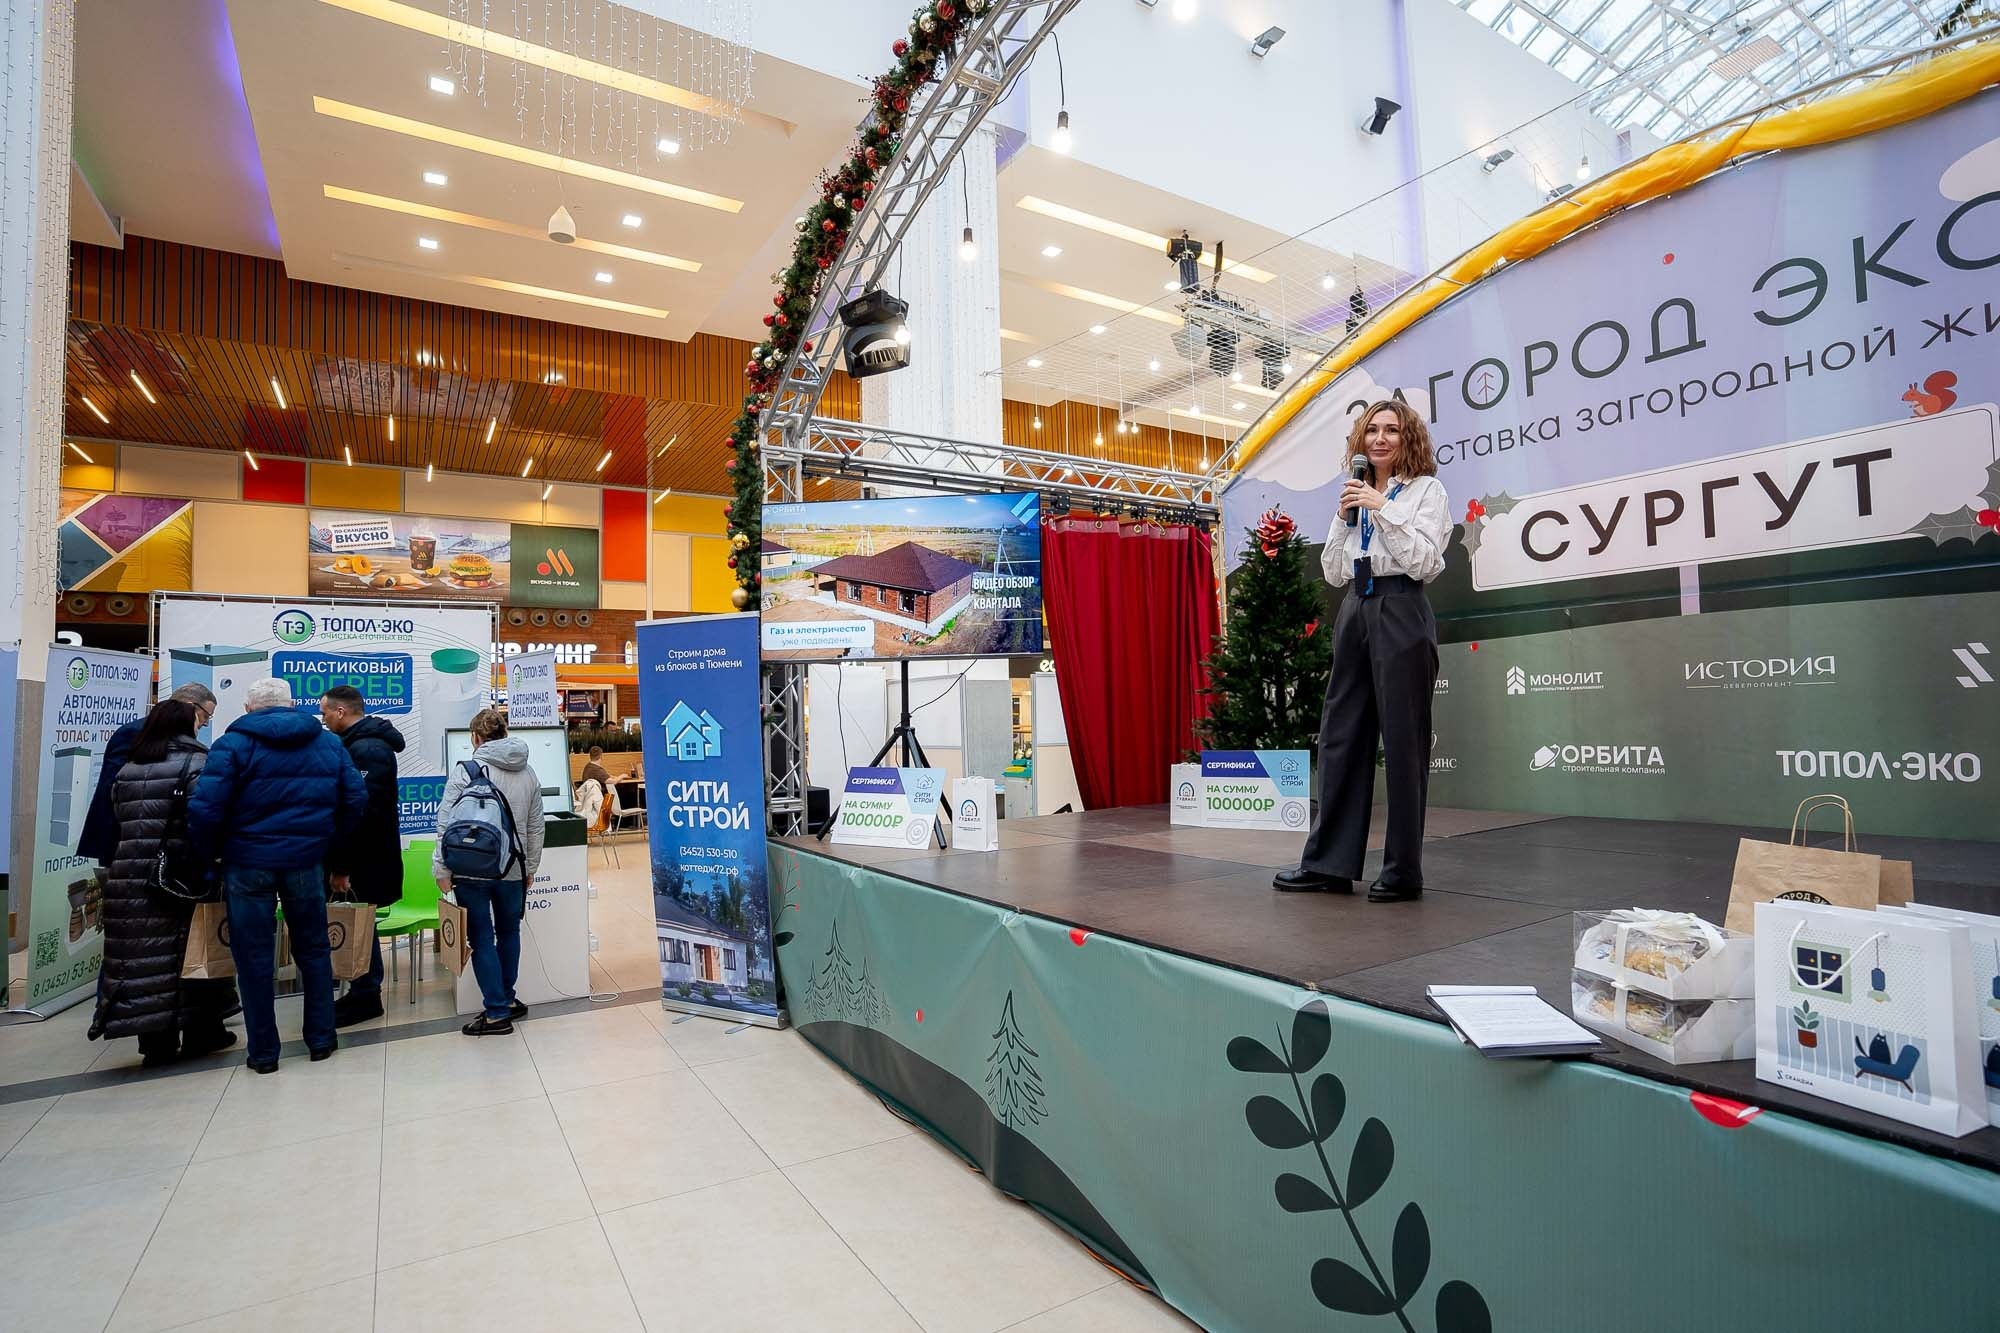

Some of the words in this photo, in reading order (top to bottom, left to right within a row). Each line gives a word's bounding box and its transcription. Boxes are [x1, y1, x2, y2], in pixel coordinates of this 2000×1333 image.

[1436, 416, 1561, 466] ставка
[1575, 326, 1896, 432] загородной
[1520, 448, 1893, 562] СУРГУТ
[335, 531, 389, 544] ВКУСНО
[973, 576, 1004, 591] ВИДЕО
[1006, 576, 1035, 589] ОБЗОР
[973, 597, 1022, 609] КВАРТАЛА
[770, 627, 786, 636] Газ
[796, 625, 867, 635] электричество
[668, 649, 702, 660] Строим
[703, 648, 726, 658] дома
[283, 660, 404, 674] ПЛАСТИКОВЫЙ
[655, 664, 666, 672] из
[667, 662, 698, 671] блоков
[706, 659, 743, 669] Тюмени
[1685, 655, 1836, 680] ИСТОРИЯ
[282, 674, 404, 697] ПОГРЕБ
[1530, 671, 1604, 686] МОНОЛИТ
[1723, 681, 1792, 689] ДЕВЕЛОПМЕНТ
[63, 694, 136, 711] АВТОНОМНАЯ
[512, 691, 549, 705] АВТОНОМНАЯ
[510, 705, 552, 719] КАНАЛИЗАЦИЯ
[56, 730, 90, 743] ТОПАС
[91, 734, 97, 742] и
[1561, 745, 1665, 765] ОРБИТА
[1561, 765, 1620, 773] строительная
[667, 780, 729, 804] СИТИ
[1206, 785, 1221, 793] НА
[1222, 785, 1260, 794] СУММУ
[397, 801, 442, 815] ЕРИИ
[845, 801, 858, 809] НА
[860, 801, 893, 810] СУММУ
[669, 801, 750, 830] СТРОЙ
[680, 847, 705, 858] (3452)
[706, 847, 738, 859] 530-510
[45, 855, 89, 873] ПОГРЕБА
[680, 863, 739, 877] коттедж72.рф
[561, 884, 580, 892] вод
[33, 983, 40, 997] 8
[41, 970, 70, 994] (3452)
